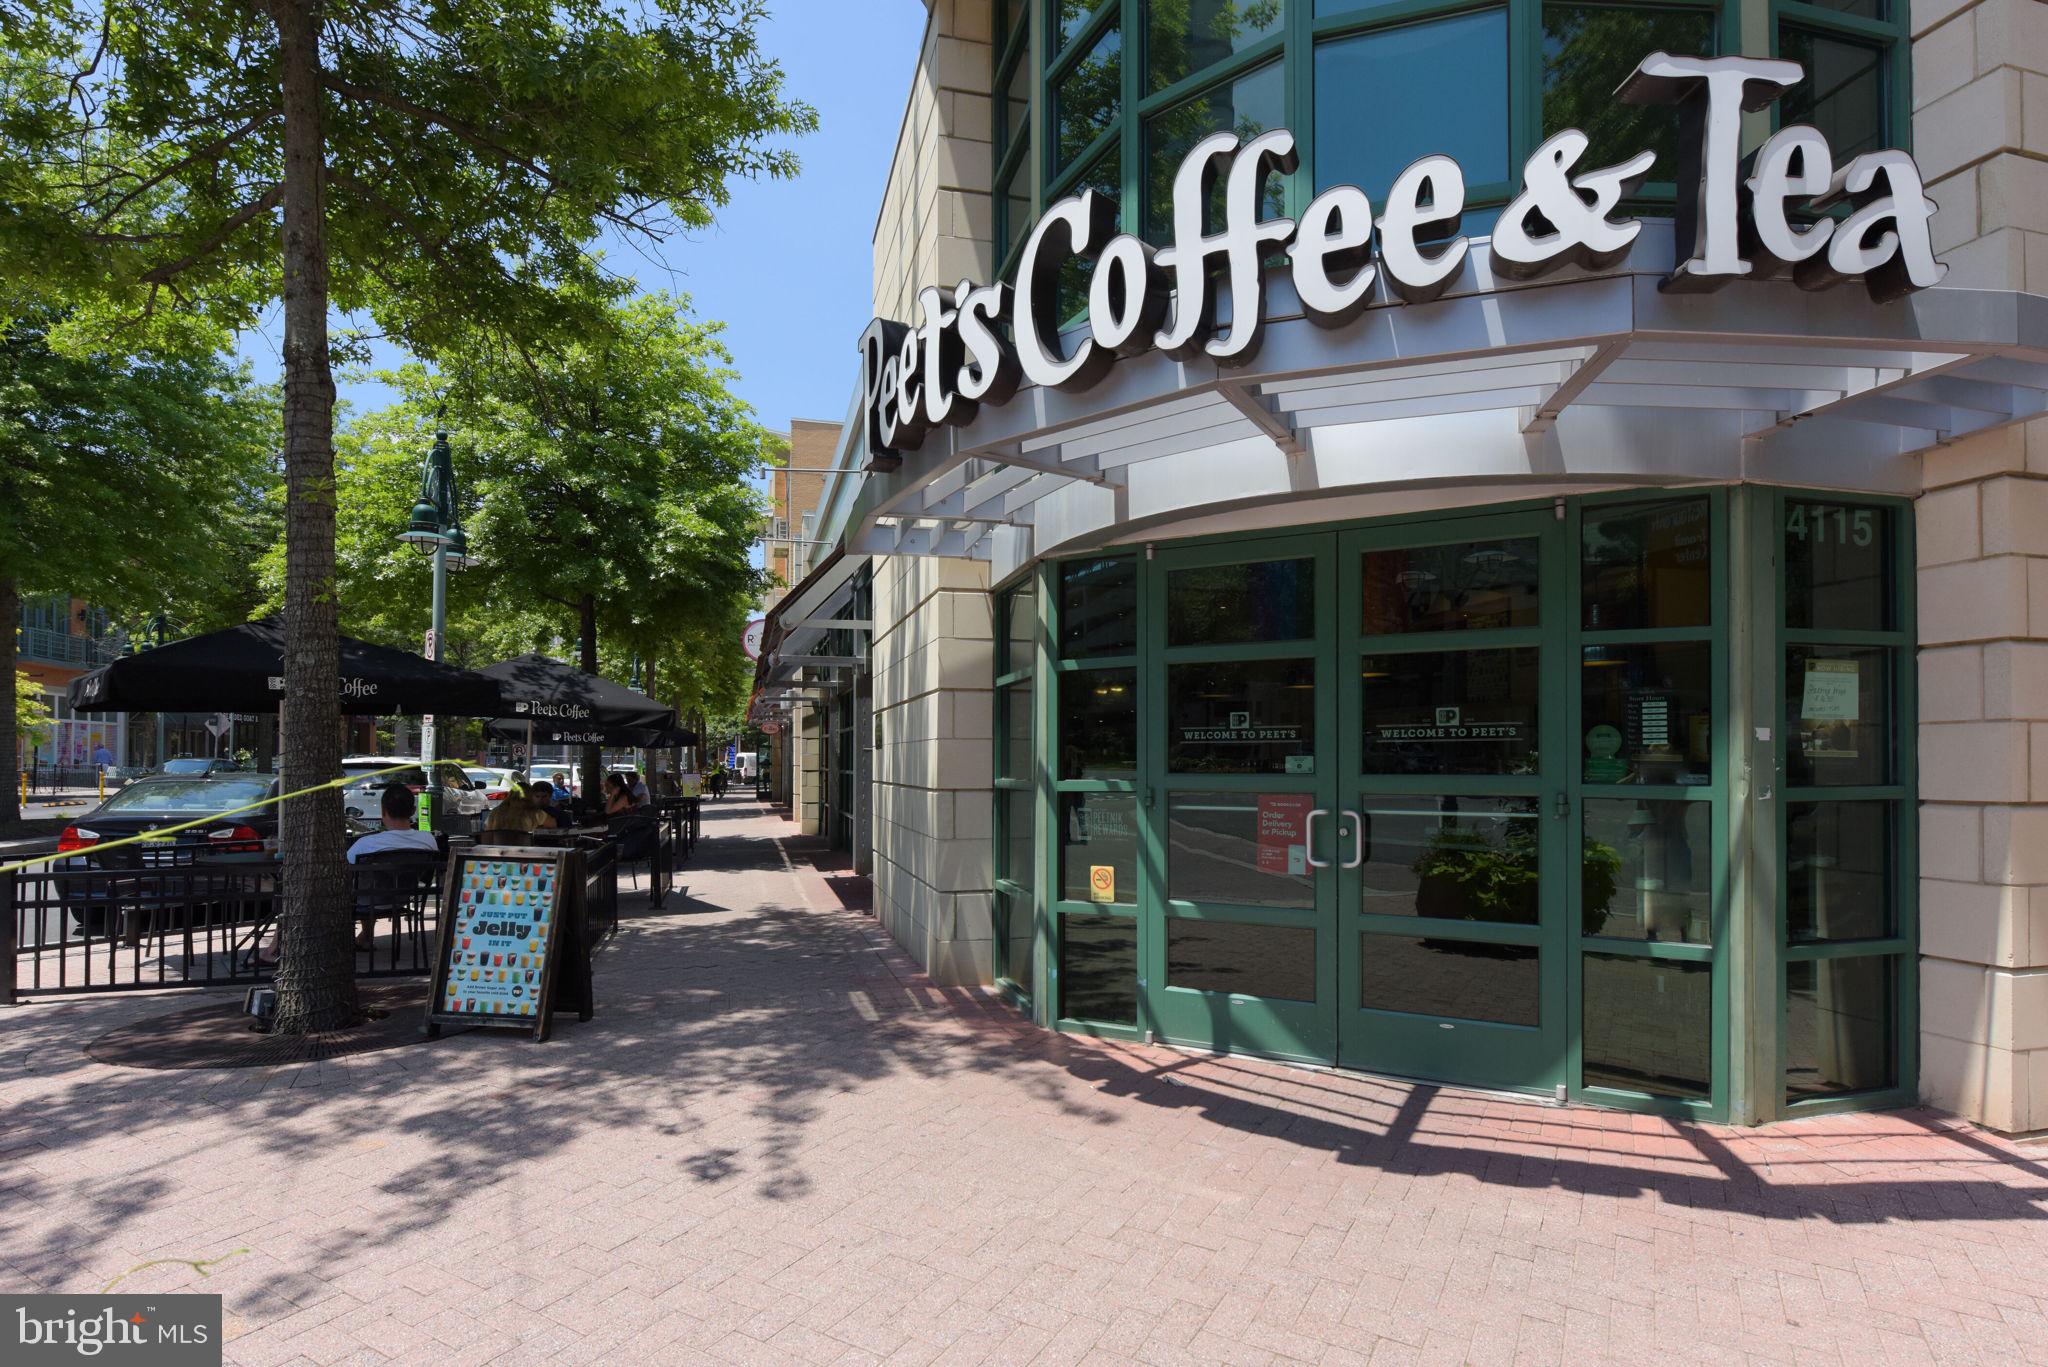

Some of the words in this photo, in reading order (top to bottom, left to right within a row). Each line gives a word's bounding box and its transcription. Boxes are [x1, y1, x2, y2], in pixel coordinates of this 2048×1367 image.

[858, 278, 1002, 472] Peet's
[1013, 129, 1468, 387] Coffee
[1491, 129, 1657, 264] &
[1640, 51, 1949, 288] Tea
[1786, 504, 1873, 547] 4115
[339, 677, 378, 698] Coffee
[559, 703, 590, 719] Coffee
[583, 732, 605, 743] Coffee
[1184, 730, 1238, 740] WELCOME
[1241, 730, 1256, 739] TO
[1259, 729, 1297, 739] PEET'S
[1381, 728, 1445, 738] WELCOME
[1449, 728, 1467, 737] TO
[1471, 727, 1517, 737] PEET'S
[1093, 810, 1127, 823] PEETNIK
[1262, 811, 1285, 819] Order
[1262, 819, 1293, 829] Delivery
[1271, 829, 1297, 838] Pickup
[480, 911, 506, 919] JUST
[472, 920, 532, 940] Jelly
